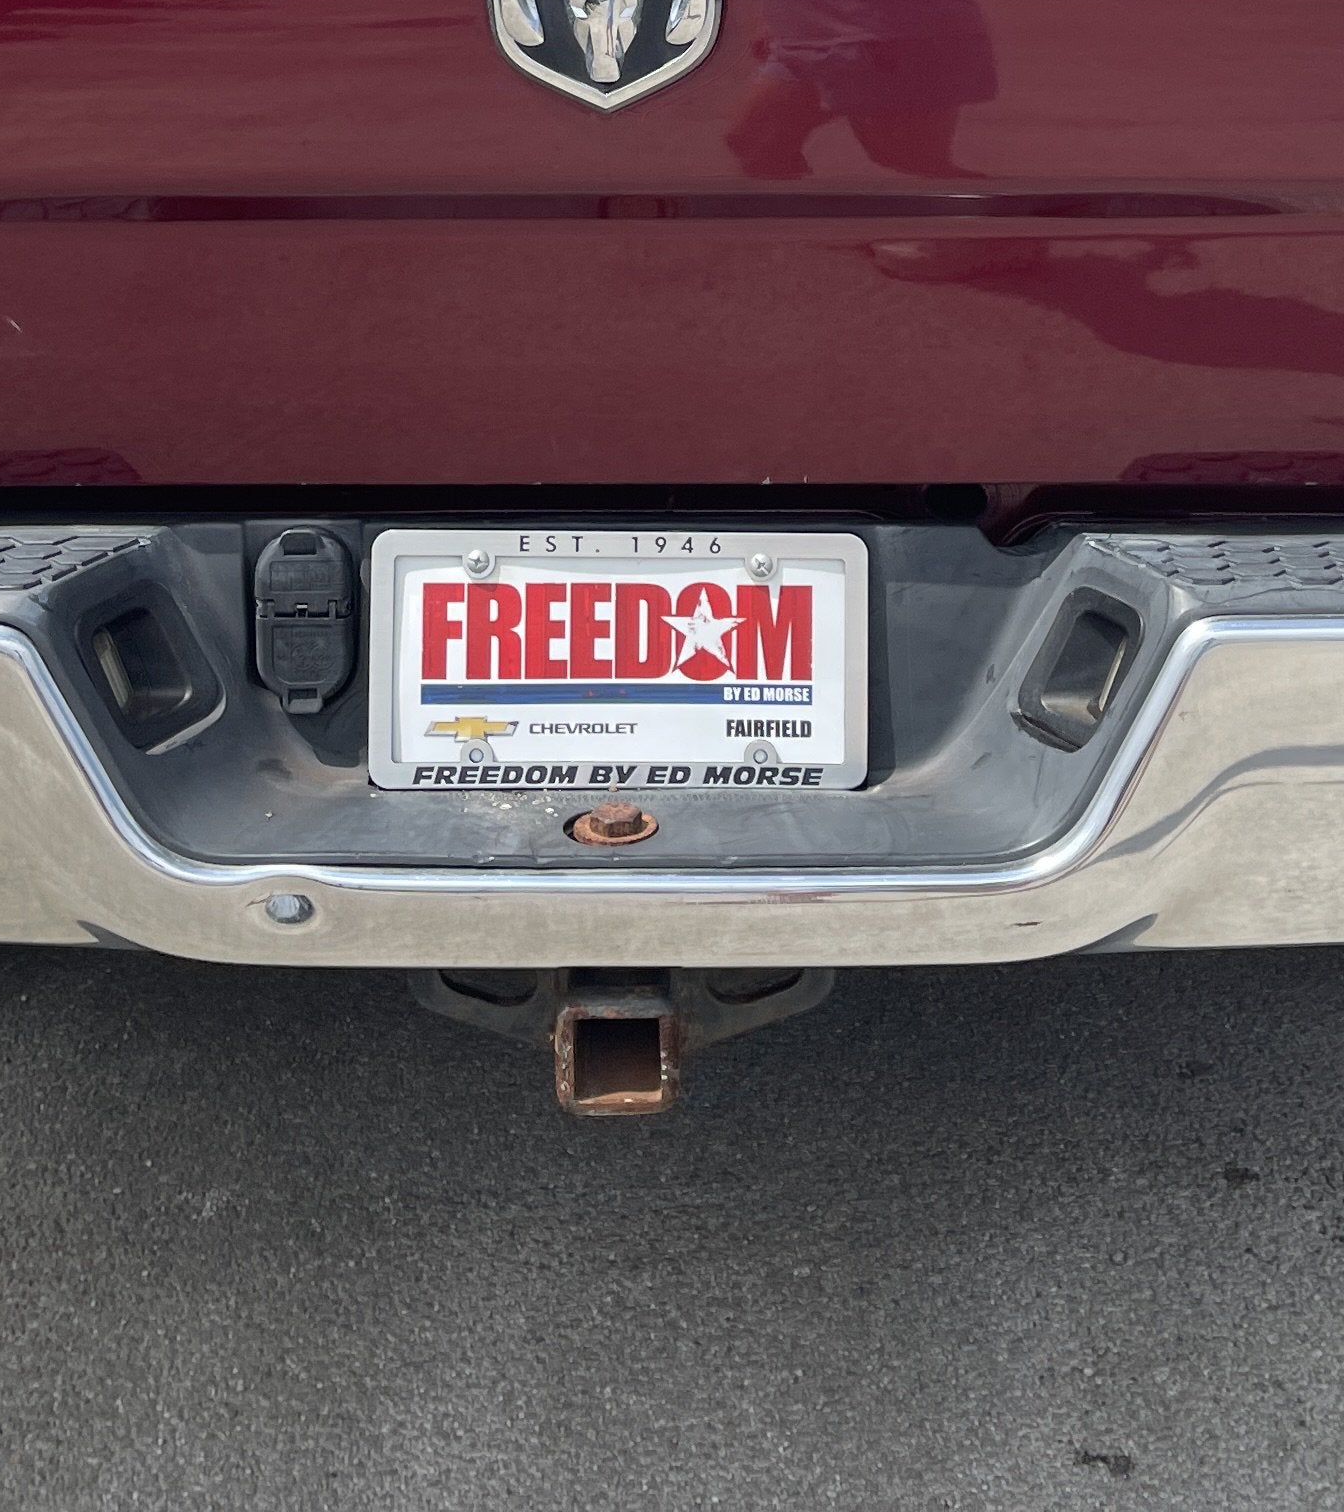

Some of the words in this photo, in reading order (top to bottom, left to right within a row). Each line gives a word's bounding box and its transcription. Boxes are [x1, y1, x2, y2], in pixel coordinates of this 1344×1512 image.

[519, 535, 601, 554] EST.
[631, 536, 723, 555] 1946
[421, 581, 814, 682] FREEDOM
[723, 687, 742, 702] BY
[743, 687, 761, 702] ED
[762, 687, 811, 703] MORSE
[528, 721, 639, 736] CHEVROLET
[725, 718, 813, 739] FAIRFIELD
[412, 765, 577, 786] FREEDOM
[588, 765, 642, 785] BY
[646, 766, 692, 786] ED
[702, 766, 824, 786] MORSE
